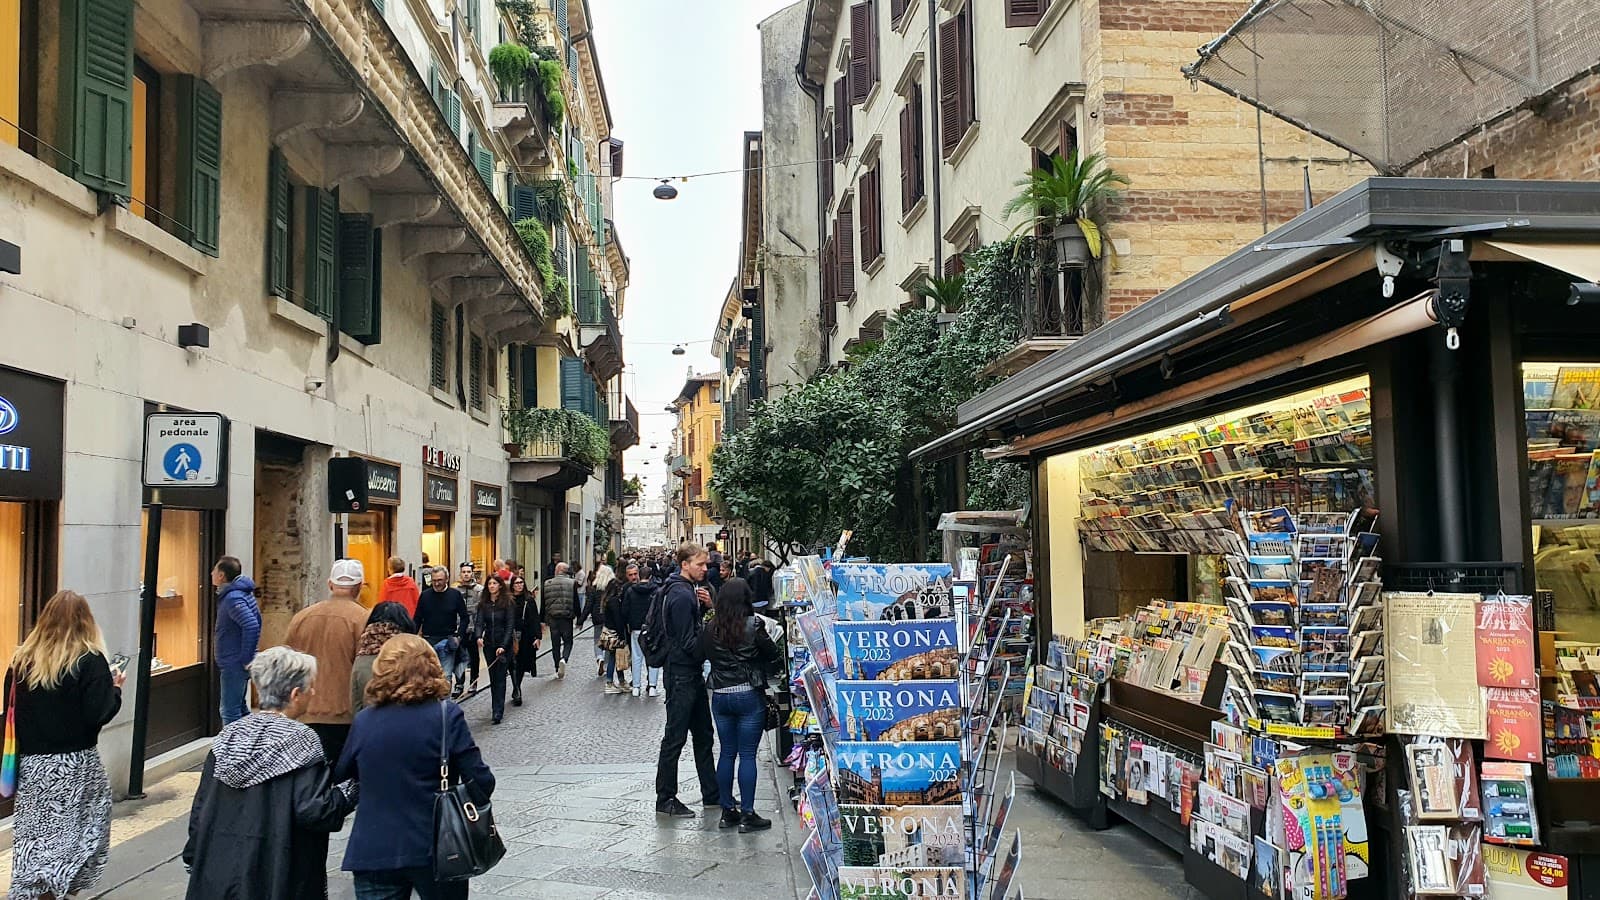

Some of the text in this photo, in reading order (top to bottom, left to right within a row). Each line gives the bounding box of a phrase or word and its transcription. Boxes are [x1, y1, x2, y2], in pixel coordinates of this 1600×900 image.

[173, 418, 196, 426] area
[160, 427, 209, 438] pedonale
[835, 574, 949, 594] VERONA
[920, 593, 949, 606] 2023
[837, 629, 953, 649] VERONA
[862, 648, 892, 661] 2023
[840, 689, 957, 708] VERONA
[865, 708, 894, 721] 2023
[842, 752, 957, 770] VERONA
[928, 769, 958, 782] 2023
[844, 814, 959, 834] VERONA
[931, 834, 961, 846] 2023
[844, 877, 959, 896] VERONA
